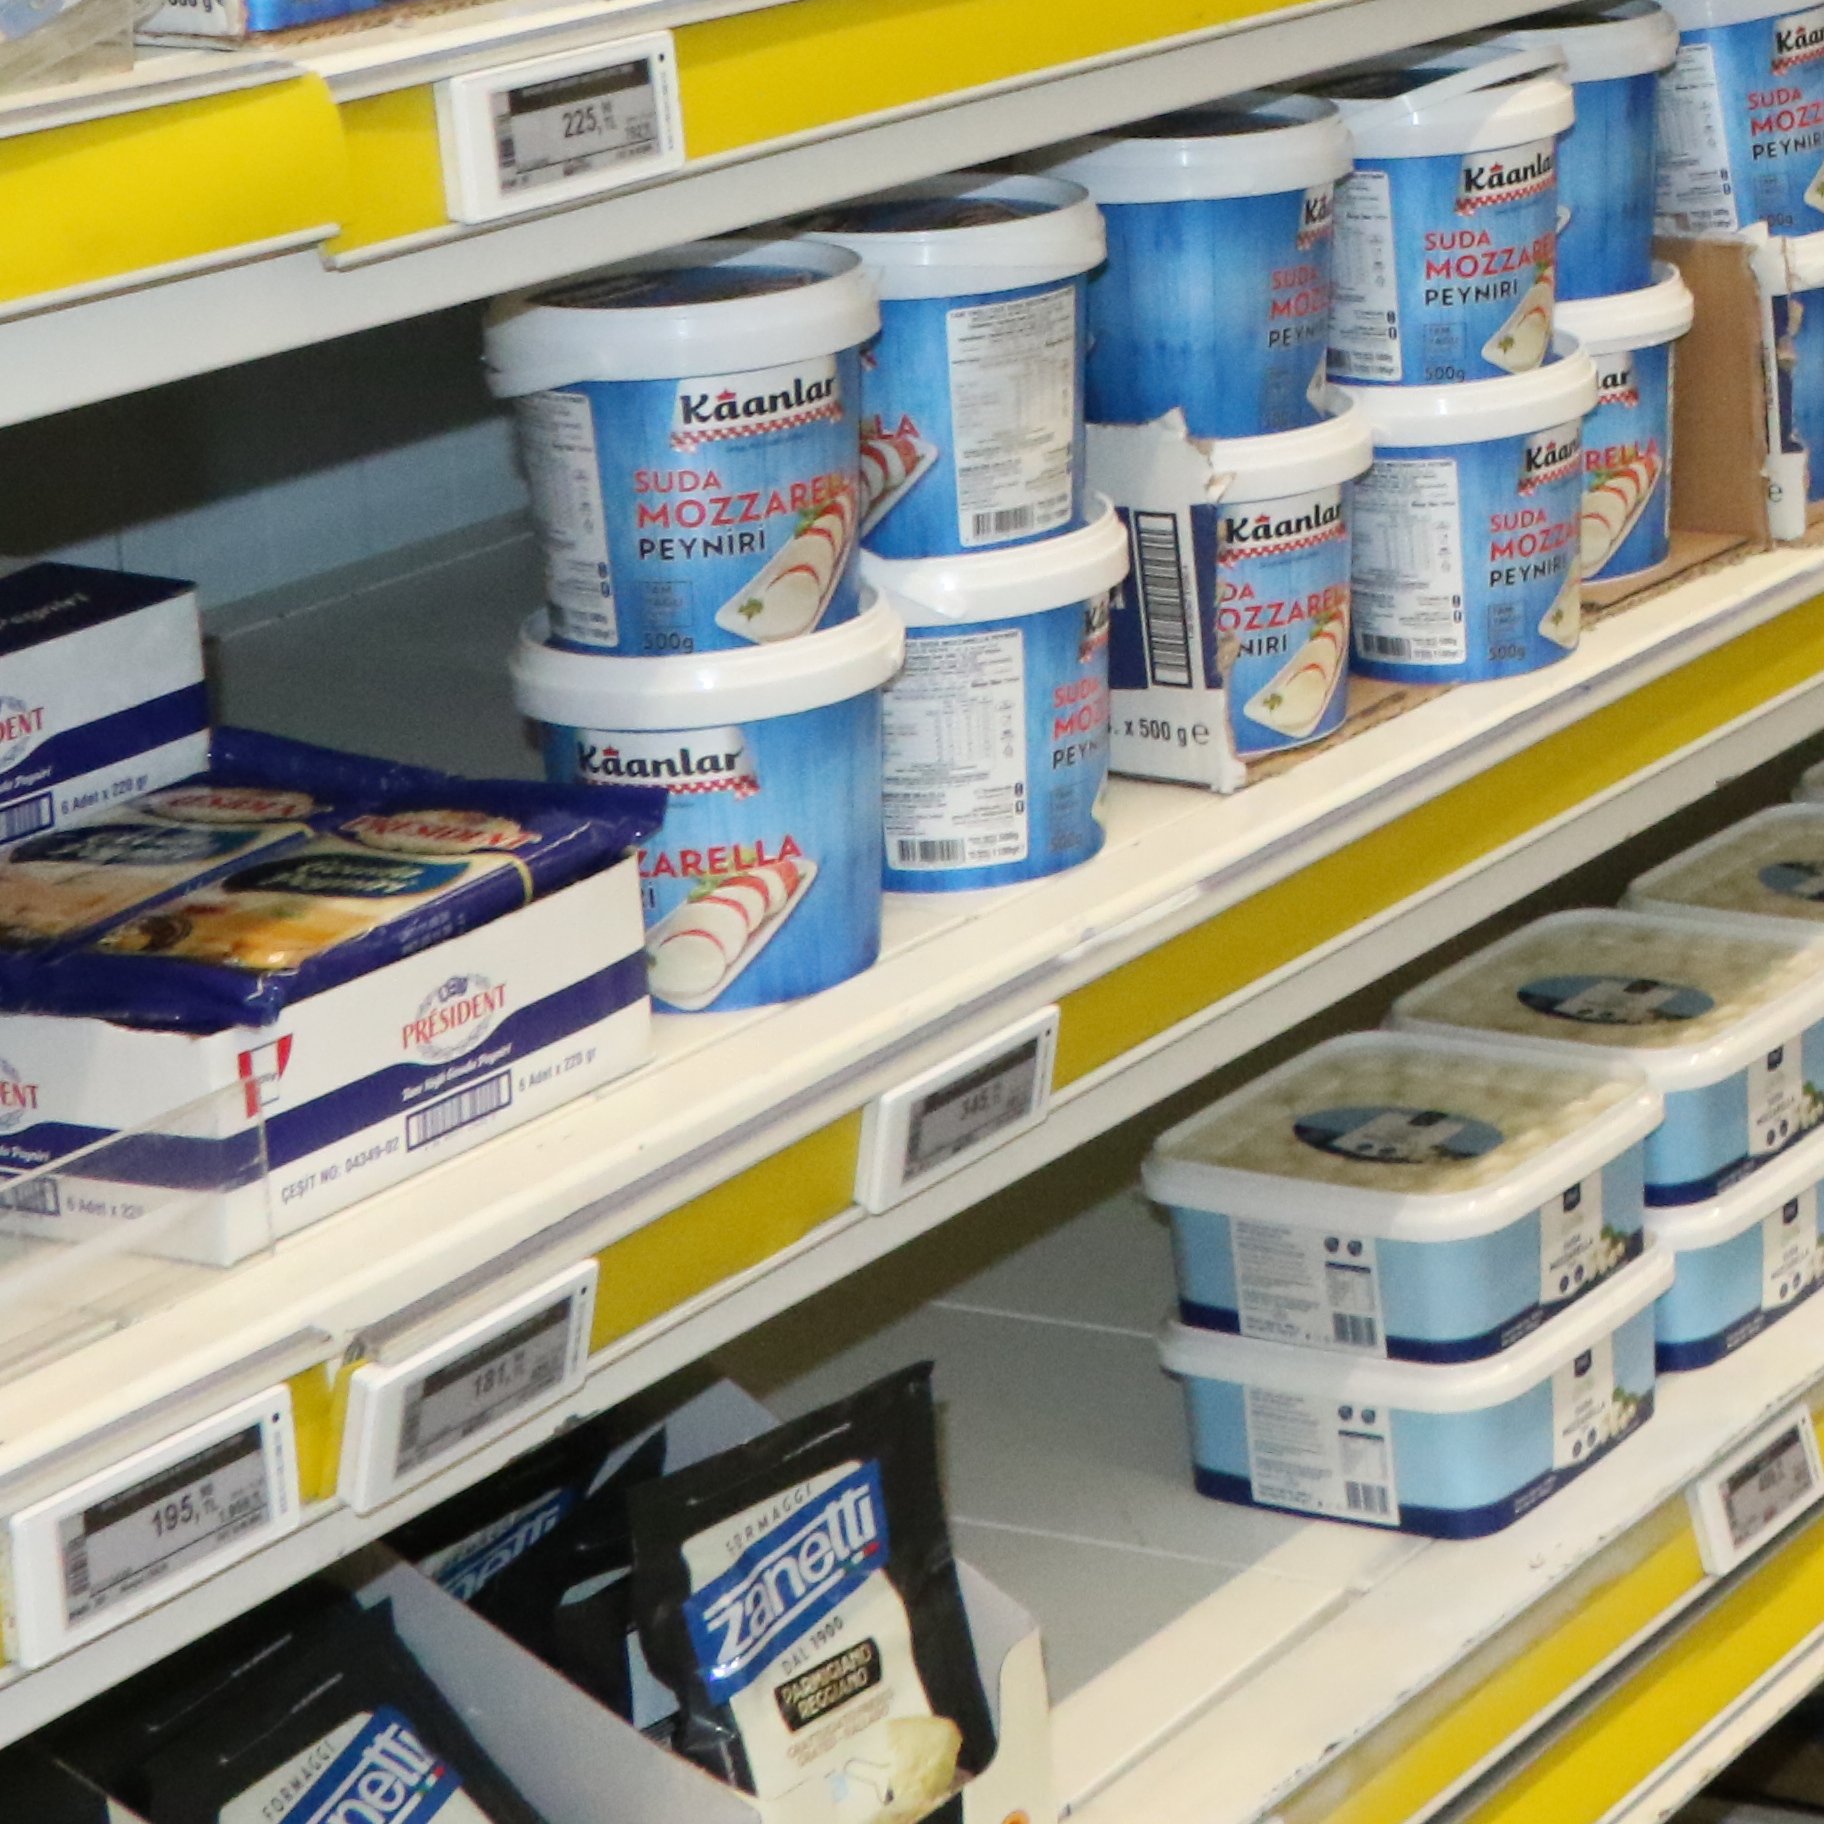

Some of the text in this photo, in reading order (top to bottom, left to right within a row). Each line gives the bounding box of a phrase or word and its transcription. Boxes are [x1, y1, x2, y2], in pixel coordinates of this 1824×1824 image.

[1747, 88, 1803, 110] SUDA
[562, 106, 602, 139] 225,
[1424, 230, 1492, 252] SUDA
[1424, 366, 1467, 384] 500g
[632, 469, 722, 494] SUDA
[1490, 510, 1547, 532] SUDA
[639, 530, 767, 561] PEYNİRİ
[643, 630, 694, 653] 500g
[1488, 644, 1526, 663] 500g
[1140, 720, 1172, 741] 500
[1177, 730, 1187, 748] g
[61, 799, 69, 815] 6
[73, 788, 98, 811] Adet
[102, 789, 109, 800] x
[112, 777, 133, 798] 220
[402, 983, 507, 1050] PRÉSIDENT
[153, 1494, 200, 1539] 195,
[780, 1617, 845, 1676] DAL 1900
